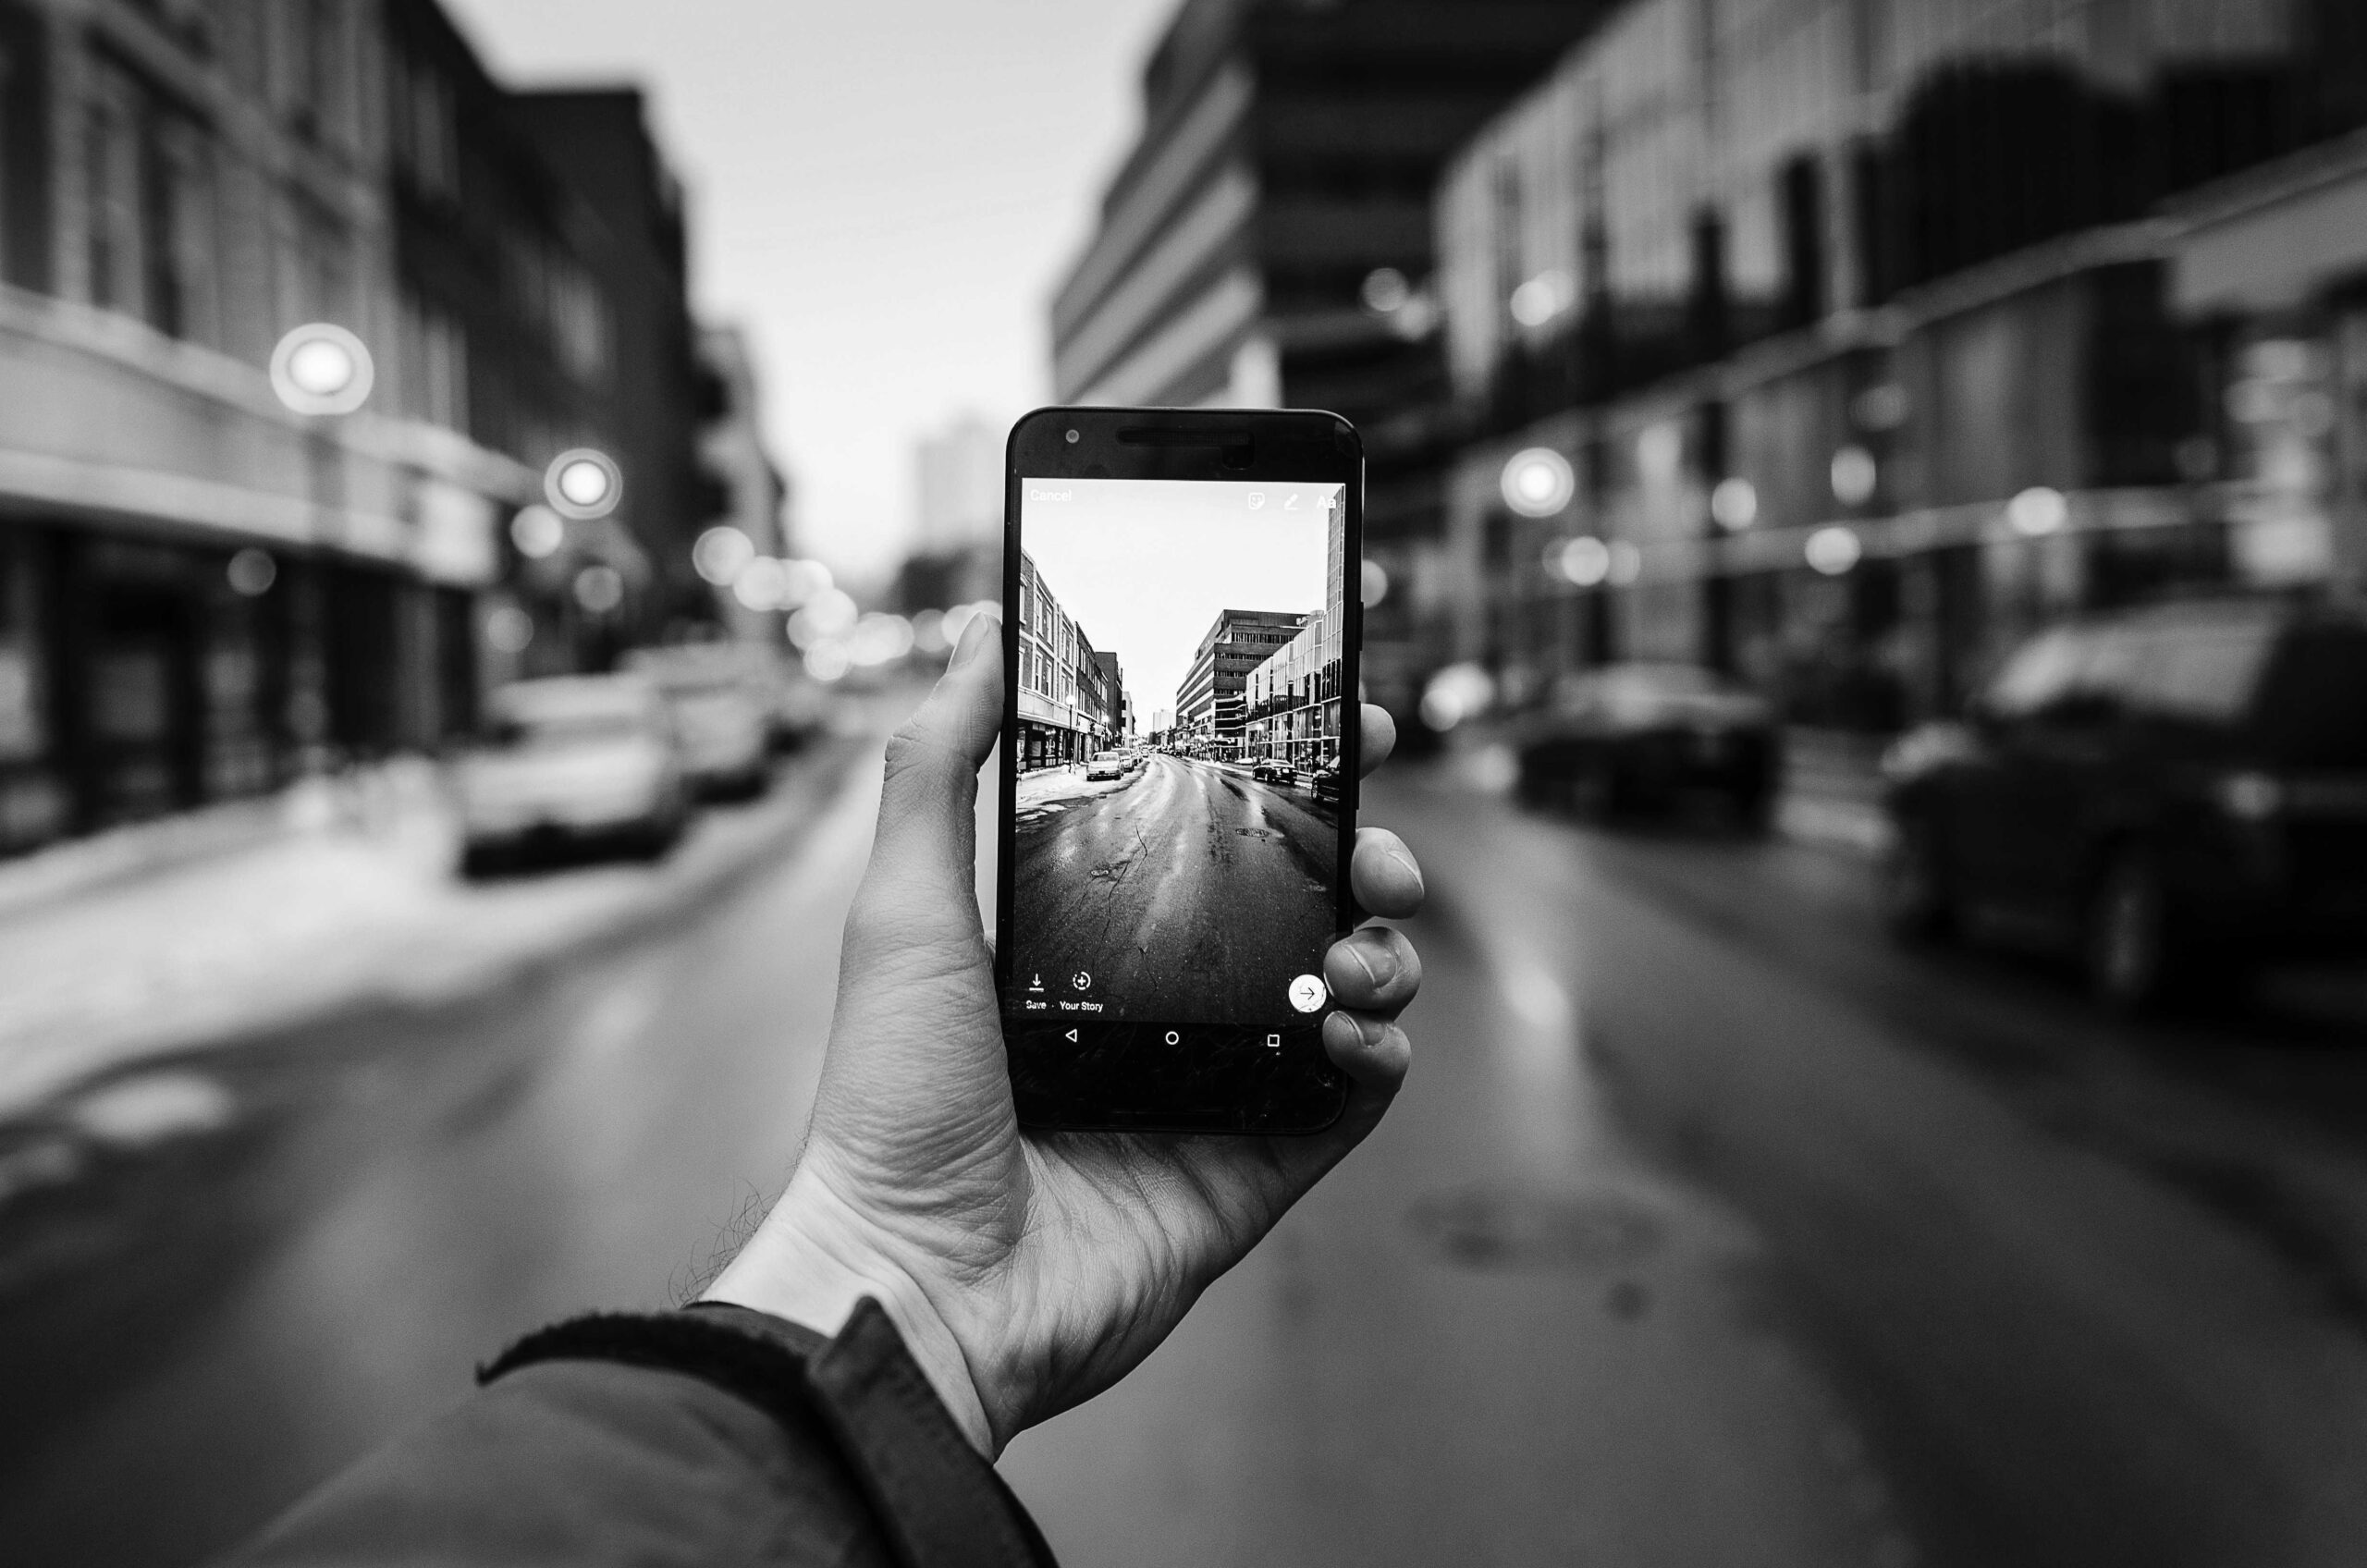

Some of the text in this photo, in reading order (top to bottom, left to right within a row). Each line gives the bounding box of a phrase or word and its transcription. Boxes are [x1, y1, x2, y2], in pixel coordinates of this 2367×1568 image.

[1030, 489, 1072, 501] Cancel
[1316, 495, 1337, 509] Aa
[1025, 999, 1047, 1010] Save
[1059, 1000, 1104, 1013] Your Story
